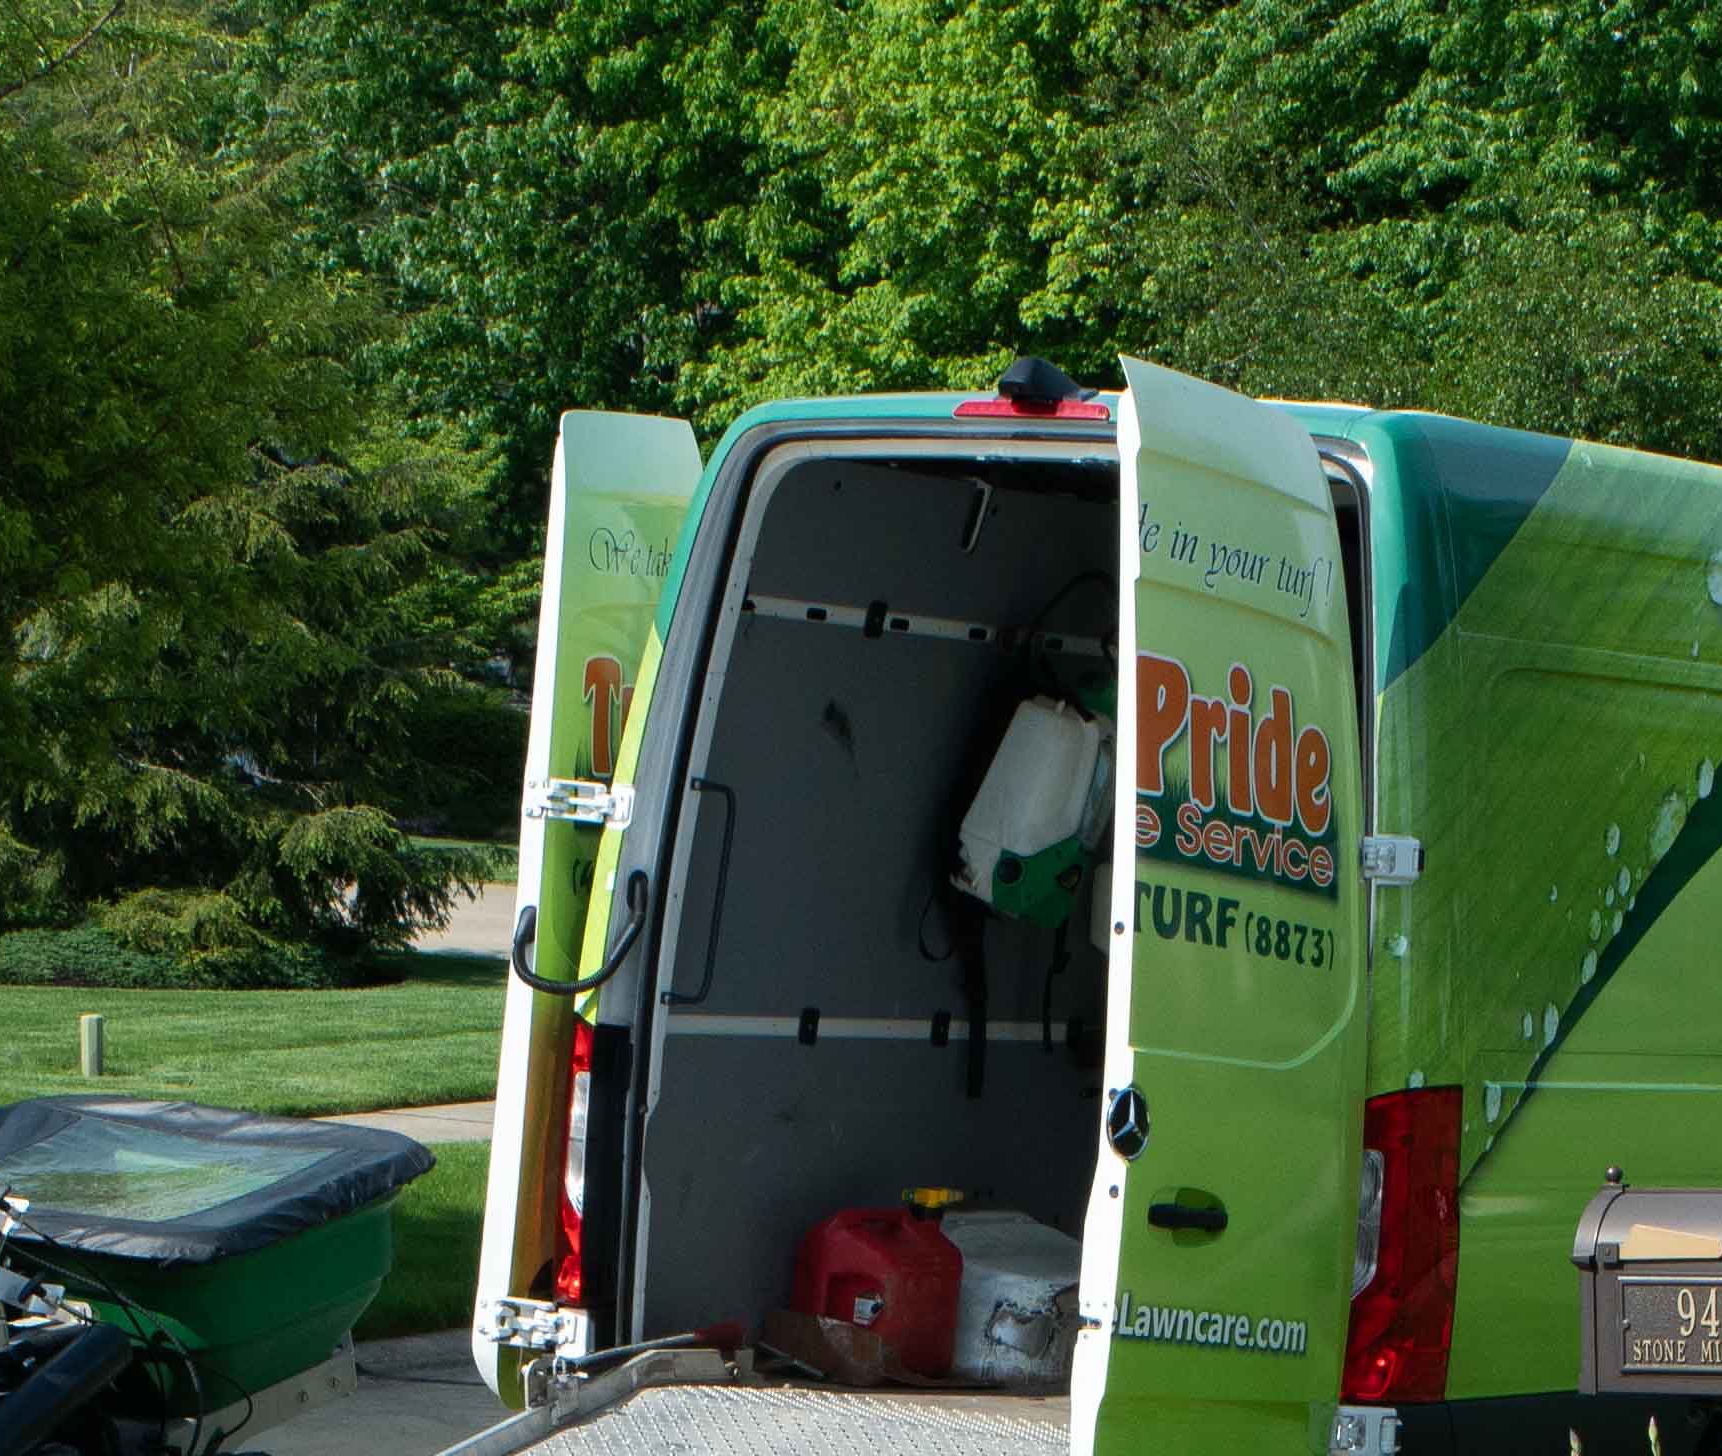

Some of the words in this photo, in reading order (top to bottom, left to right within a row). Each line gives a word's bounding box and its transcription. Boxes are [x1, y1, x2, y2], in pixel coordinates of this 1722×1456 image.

[589, 527, 641, 575] We
[646, 537, 673, 577] tak
[1170, 521, 1198, 563] in
[1205, 543, 1269, 588] your
[1135, 650, 1331, 837] Pride
[1176, 803, 1334, 887] Service
[1633, 1339, 1686, 1363] STONE
